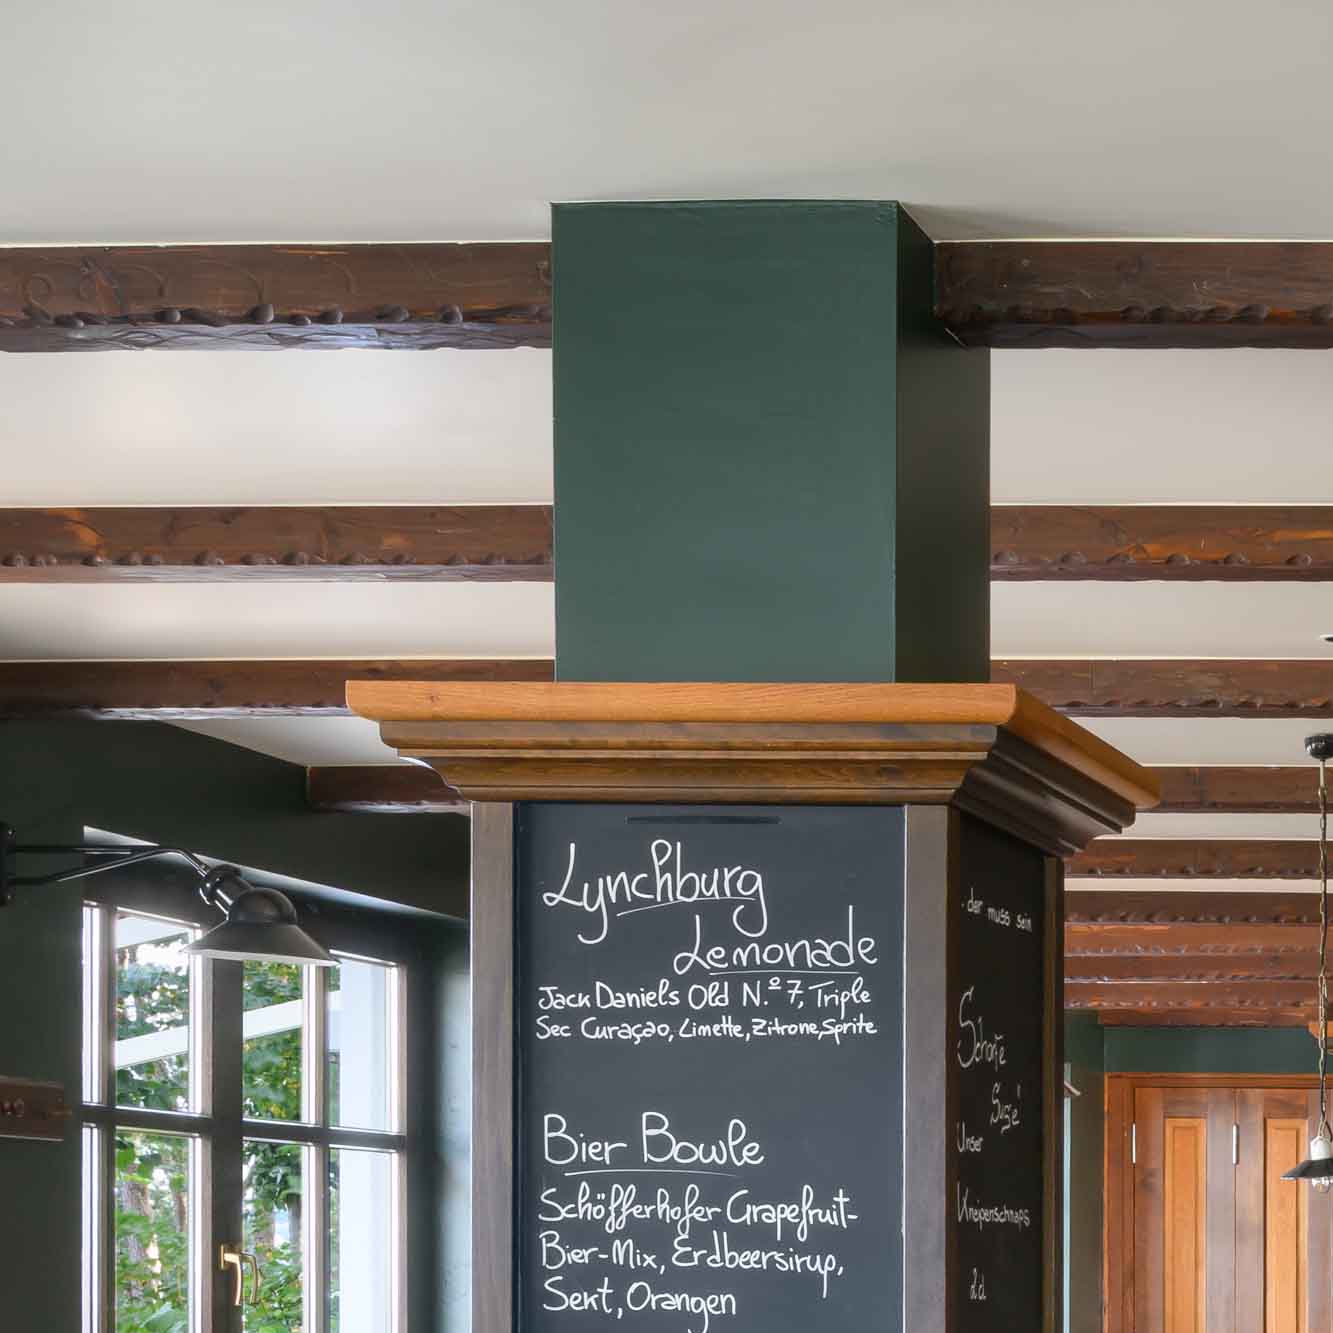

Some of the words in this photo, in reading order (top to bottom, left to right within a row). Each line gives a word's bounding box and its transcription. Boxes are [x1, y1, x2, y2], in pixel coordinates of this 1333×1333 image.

[541, 838, 770, 945] Lynchburg
[672, 905, 879, 974] Lemonade
[538, 986, 591, 1009] Jack
[596, 979, 680, 1009] Daniels
[688, 980, 729, 1008] Old
[809, 977, 871, 1019] Triple
[536, 1017, 572, 1040] Sec
[581, 1017, 673, 1045] Curaçao,
[679, 1017, 750, 1042] Limette,
[543, 1113, 628, 1165] Bier
[642, 1111, 765, 1166] Bowle
[957, 1121, 984, 1152] Unser
[538, 1181, 721, 1234] Schöfferhofer
[726, 1184, 858, 1242] Grapefruit-
[957, 1181, 1030, 1231] Kneipenschnaps
[539, 1231, 665, 1274] Bier-Mix,
